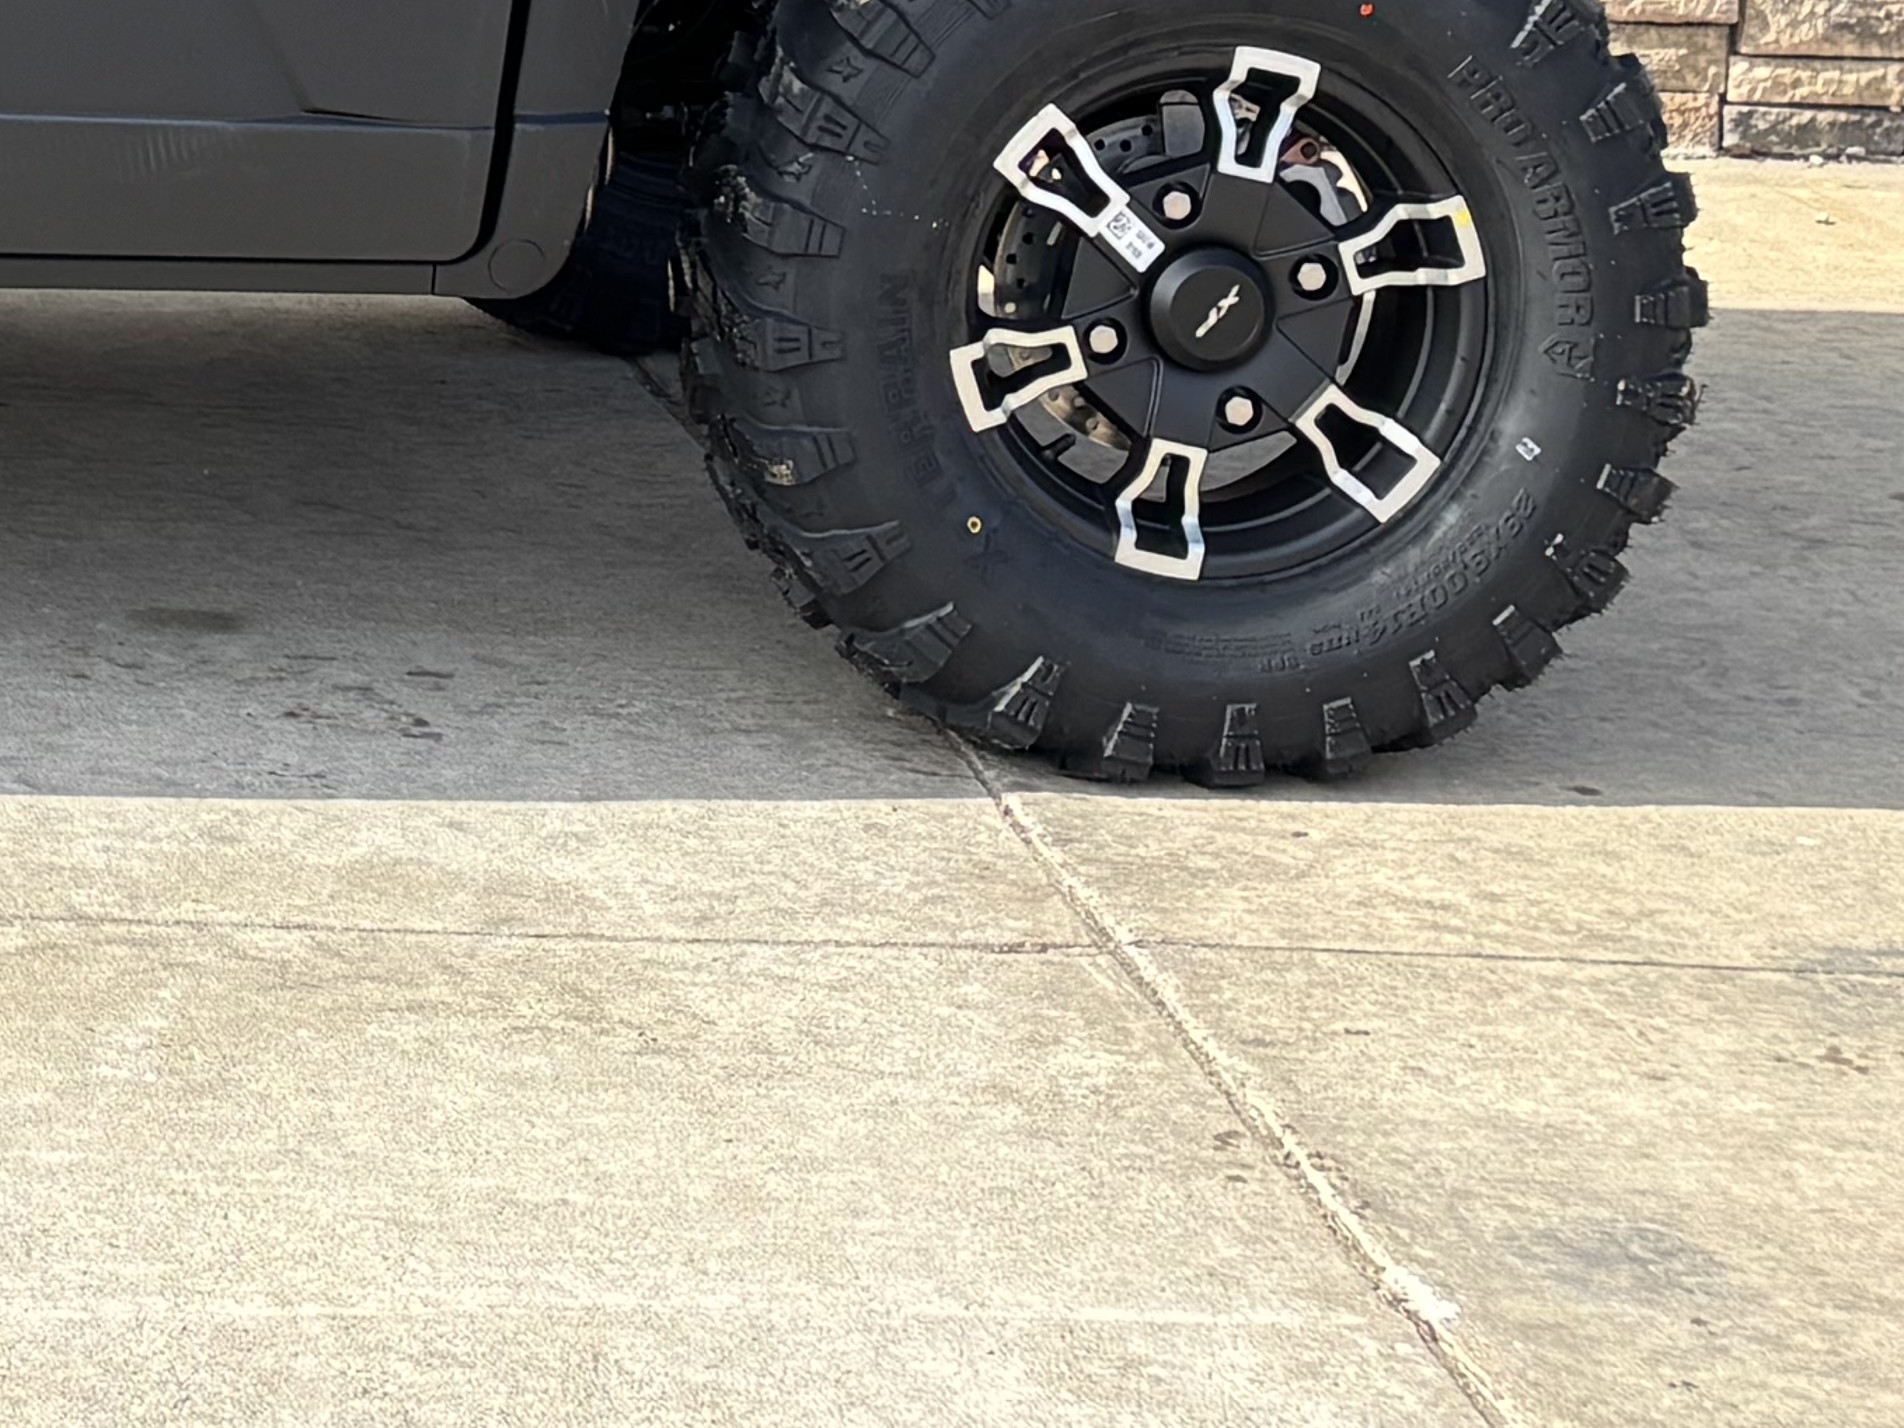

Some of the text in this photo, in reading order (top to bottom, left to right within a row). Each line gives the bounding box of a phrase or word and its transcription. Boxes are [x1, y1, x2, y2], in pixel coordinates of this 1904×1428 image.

[1446, 53, 1593, 327] PRO ARMOR
[1195, 283, 1240, 338] XP
